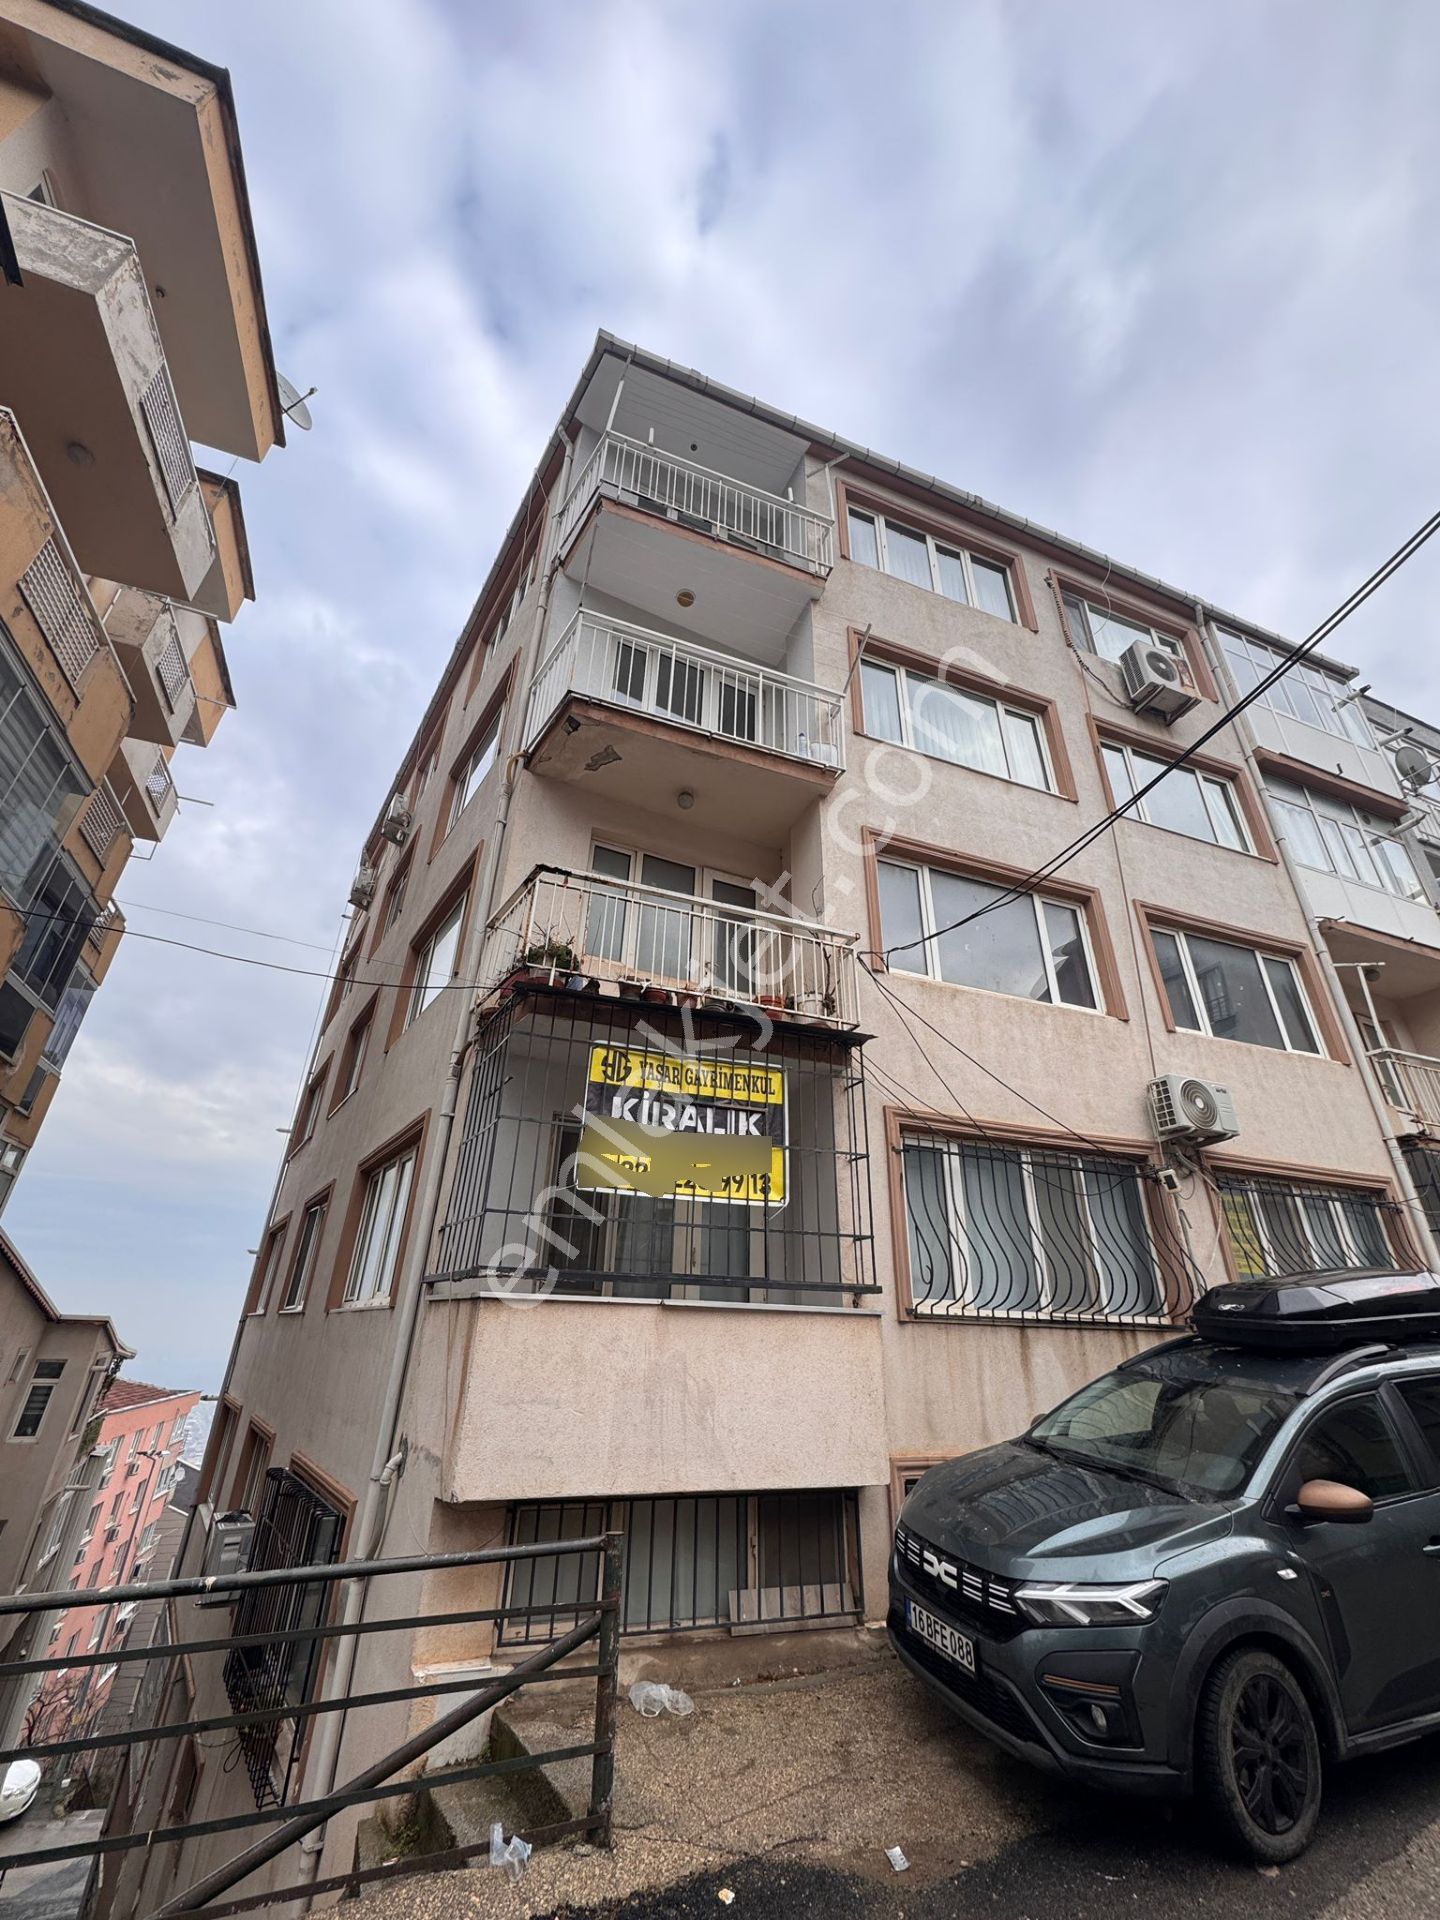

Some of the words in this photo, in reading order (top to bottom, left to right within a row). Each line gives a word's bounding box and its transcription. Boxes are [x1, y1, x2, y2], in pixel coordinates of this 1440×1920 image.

[685, 1067, 776, 1096] GAYRİMENKUL
[611, 1090, 763, 1137] KİRALIK
[912, 1605, 925, 1633] 16
[925, 1613, 949, 1651] BFE
[949, 1630, 973, 1668] 088
